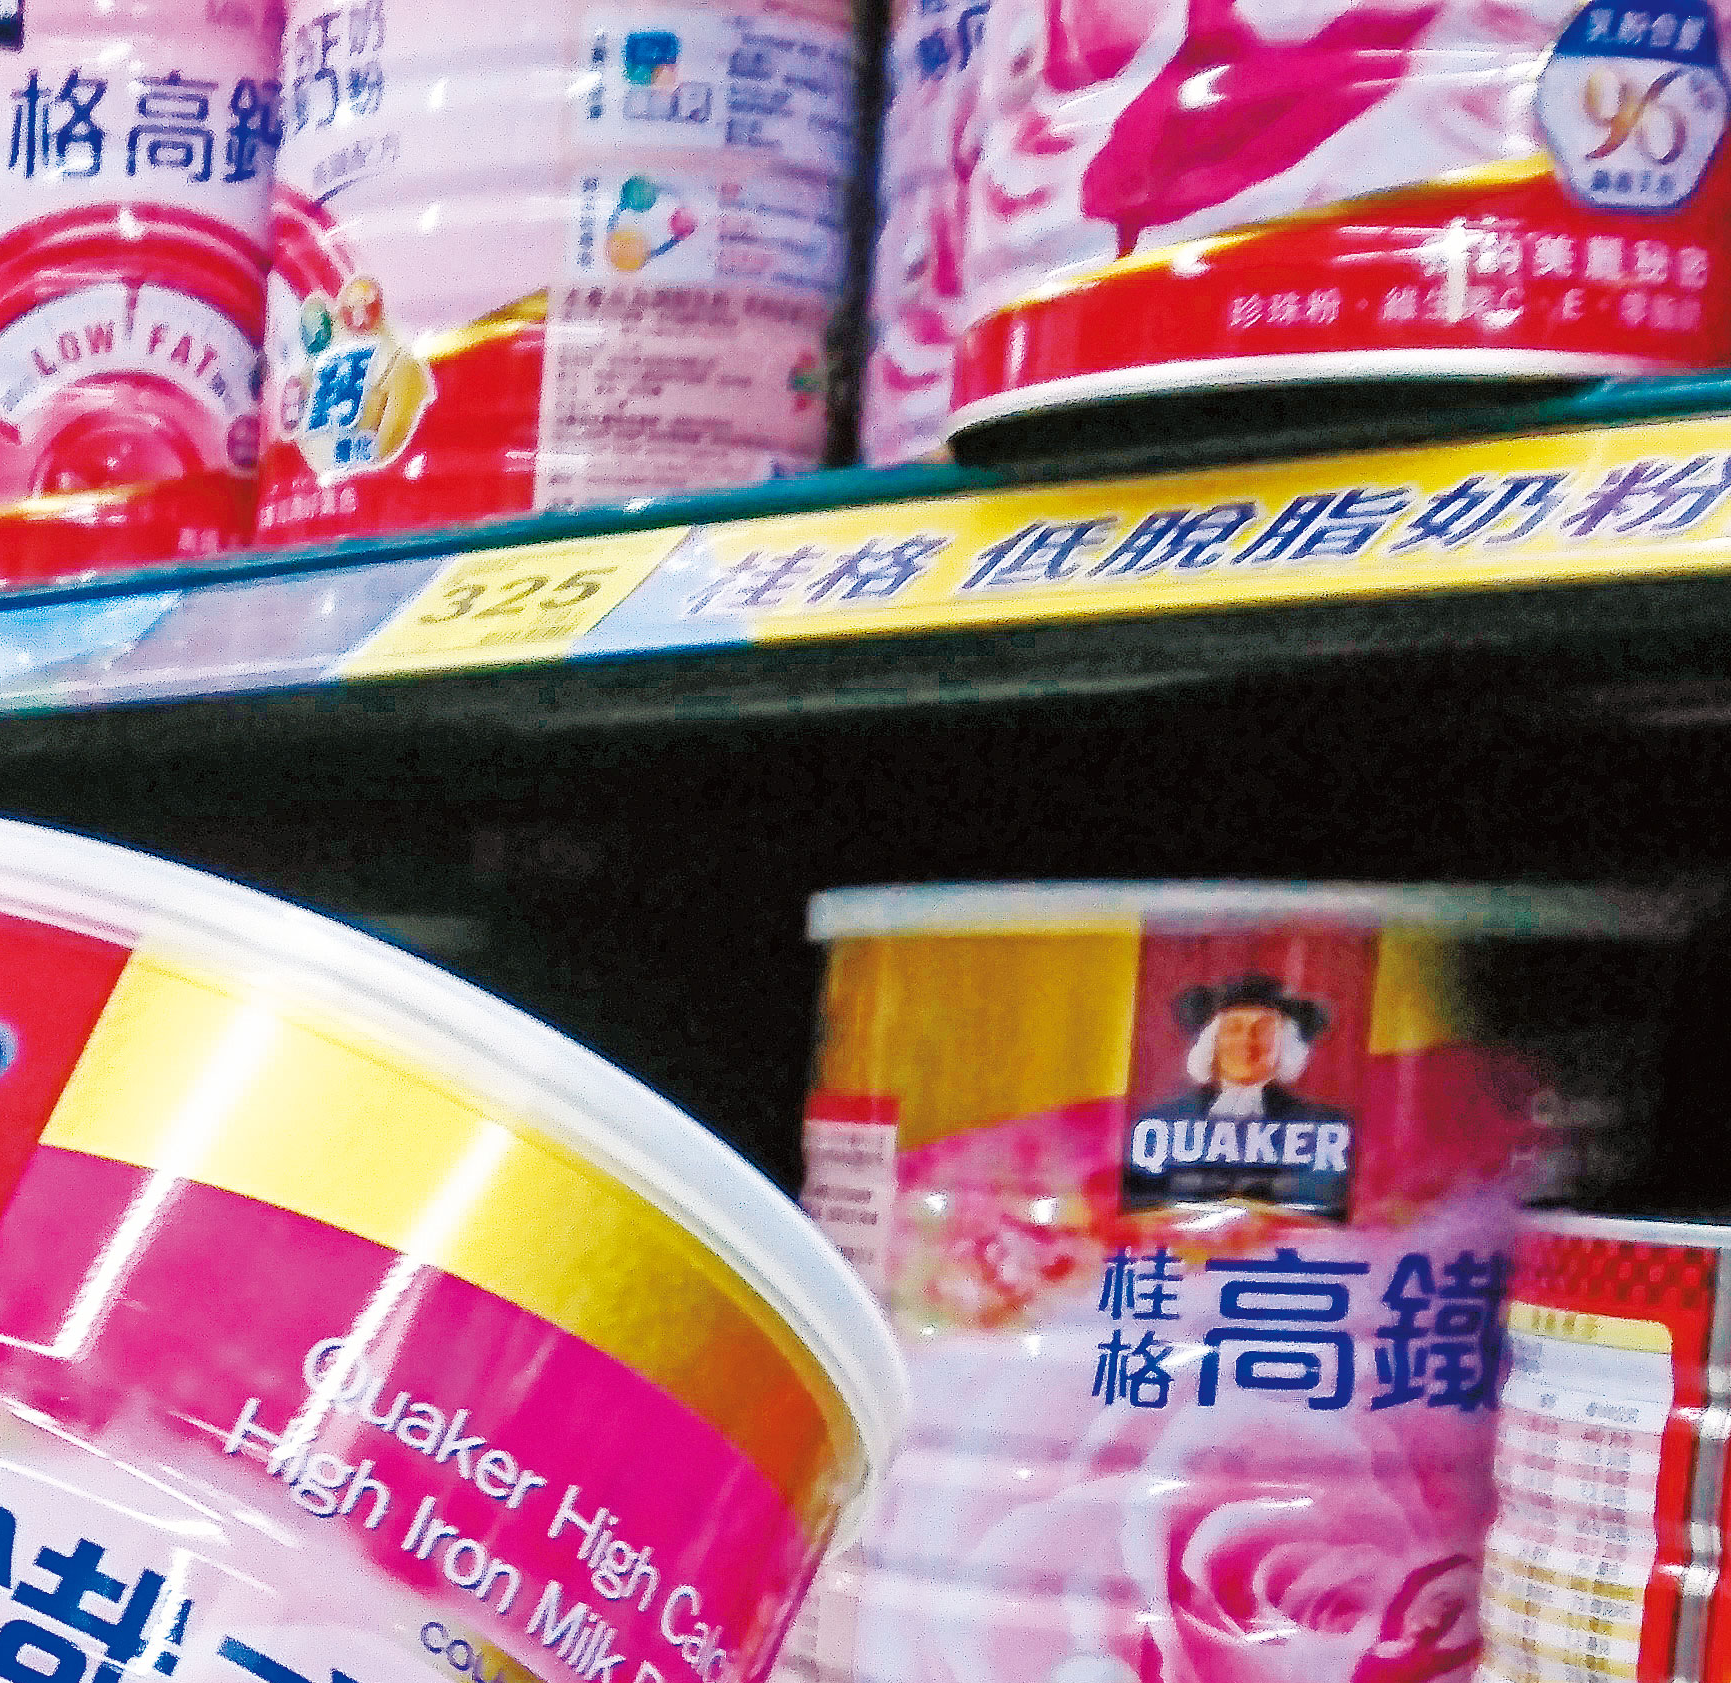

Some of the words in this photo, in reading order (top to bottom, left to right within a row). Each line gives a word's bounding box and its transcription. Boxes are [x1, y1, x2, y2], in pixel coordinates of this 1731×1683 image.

[30, 320, 116, 376] LOW
[146, 321, 219, 378] FAT
[963, 453, 1731, 591] 低脫脂奶粉
[417, 566, 619, 625] 325
[1131, 1117, 1352, 1174] QUAKER
[1092, 1246, 1185, 1409] 桂格
[222, 1396, 392, 1531] High
[400, 1494, 525, 1614] Iron
[302, 1336, 546, 1511] Quaker
[548, 1493, 662, 1612] High
